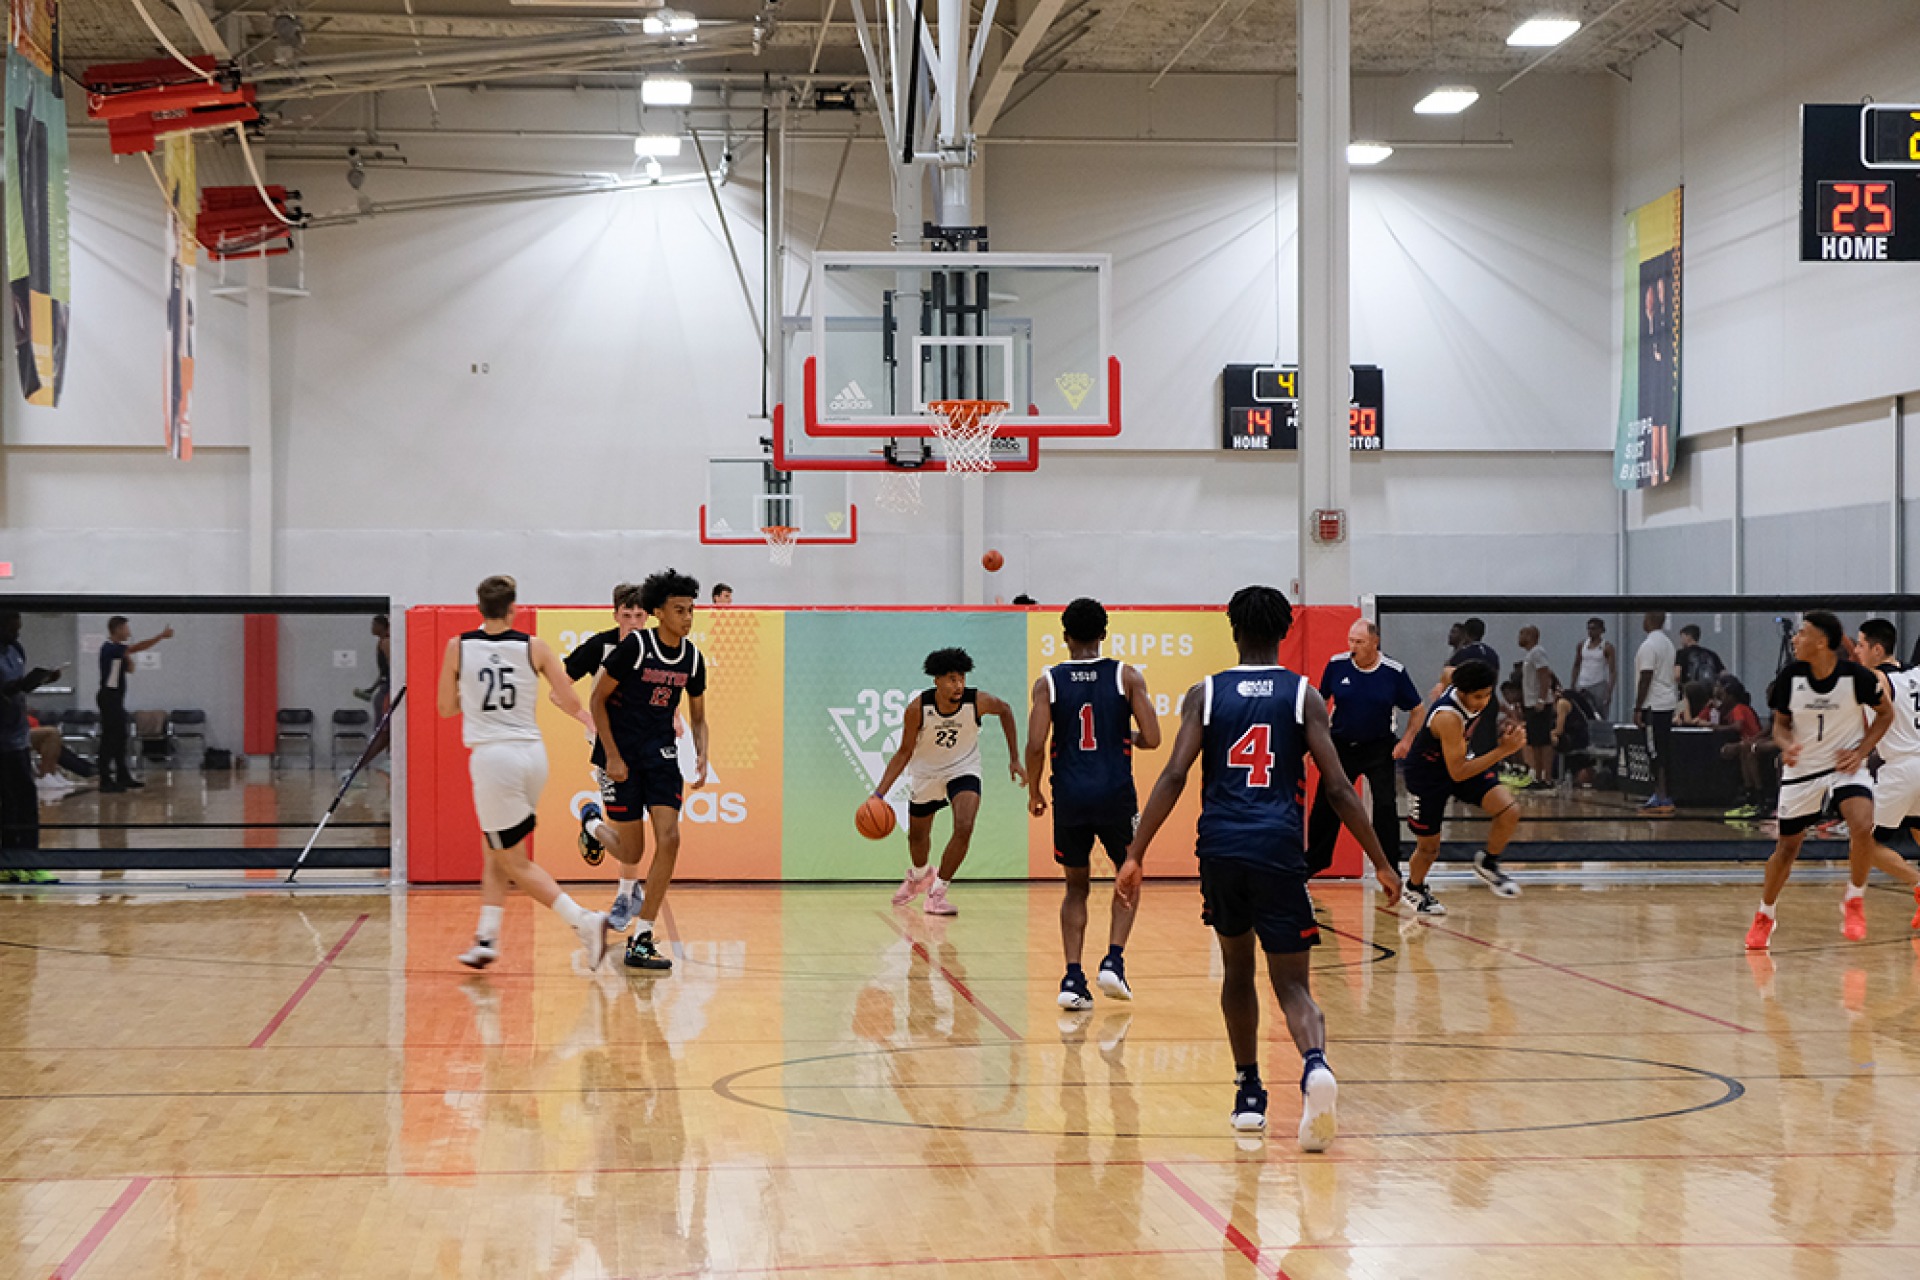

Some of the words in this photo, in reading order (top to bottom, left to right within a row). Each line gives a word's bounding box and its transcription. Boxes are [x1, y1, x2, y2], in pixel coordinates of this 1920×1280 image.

[1832, 183, 1892, 233] 25
[1822, 236, 1888, 260] HOME
[829, 396, 873, 410] adidas
[1247, 408, 1272, 435] 14
[1232, 436, 1270, 449] HOME
[1041, 634, 1194, 656] 3-RIPES
[478, 667, 516, 711] 25
[648, 686, 673, 707] 12
[934, 729, 959, 749] 23
[1078, 702, 1098, 751] 1
[1816, 713, 1825, 742] 1
[1227, 723, 1275, 788] 4
